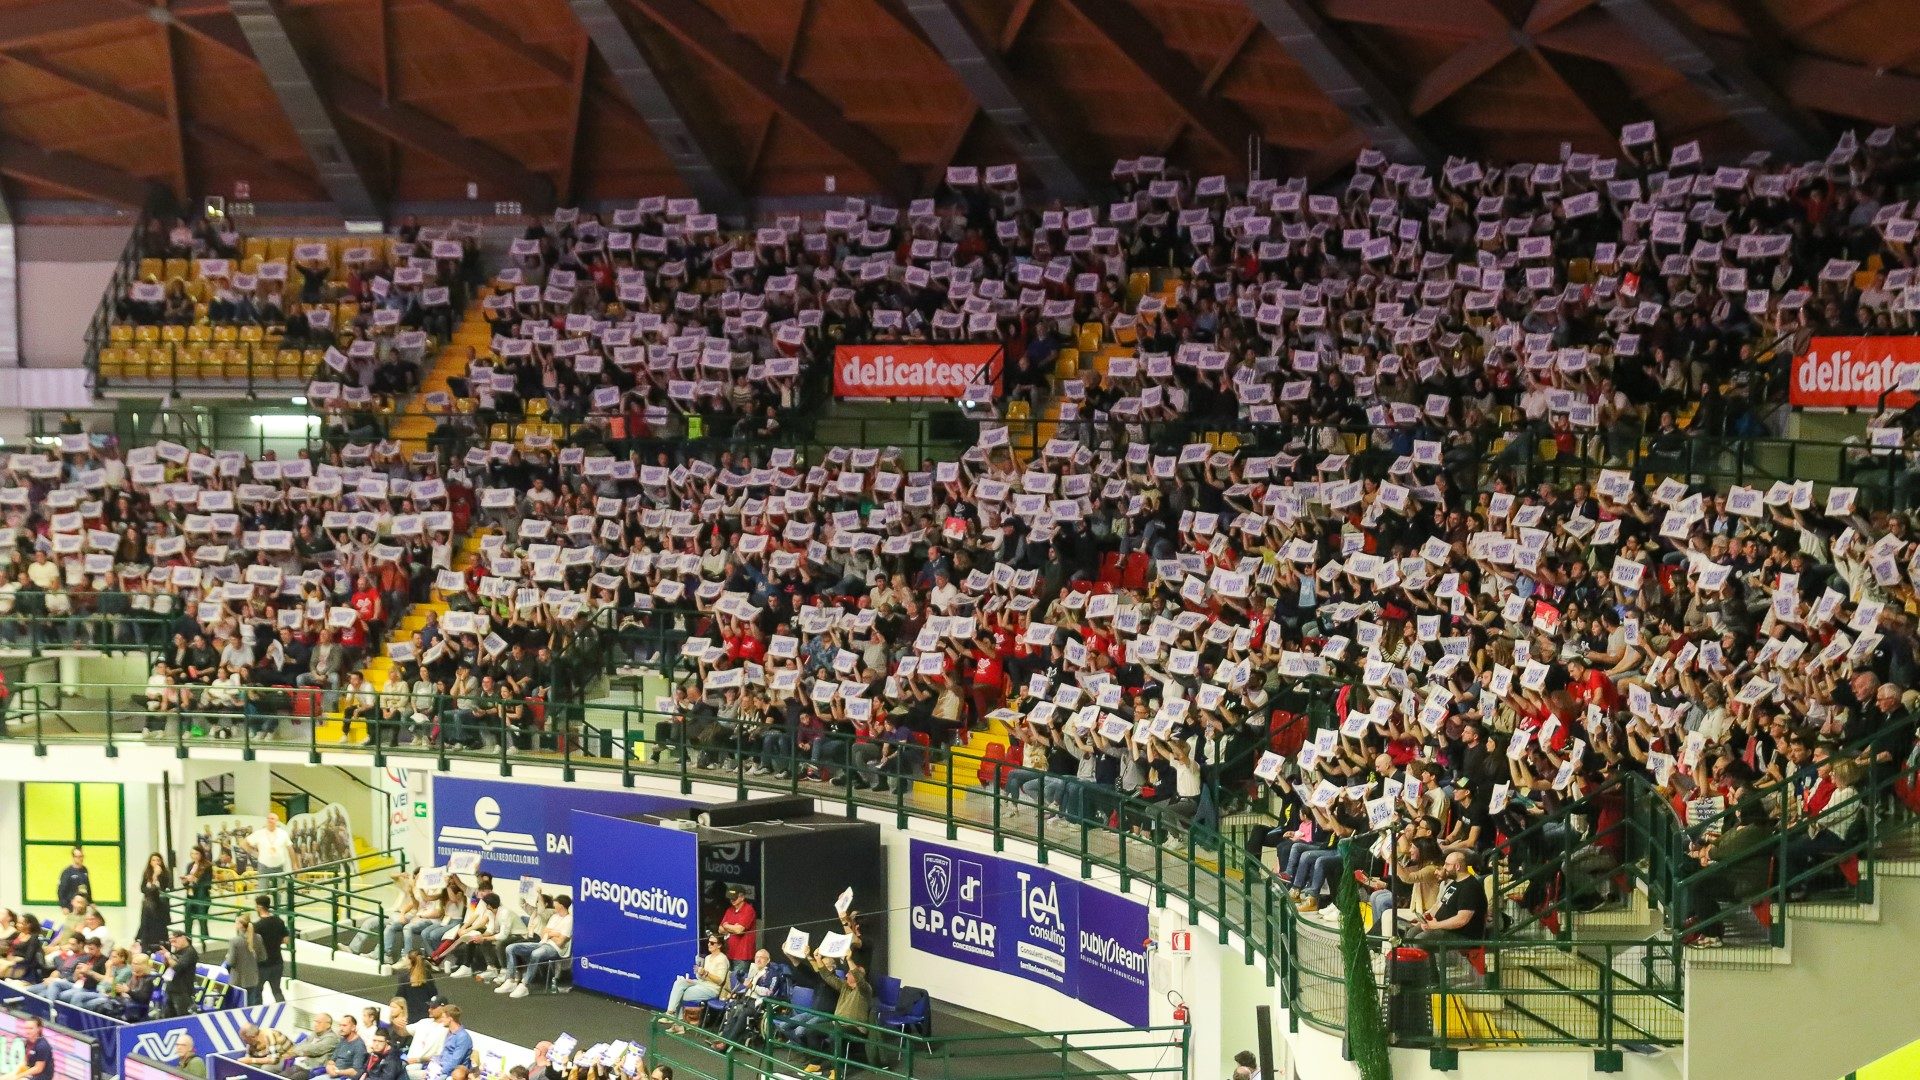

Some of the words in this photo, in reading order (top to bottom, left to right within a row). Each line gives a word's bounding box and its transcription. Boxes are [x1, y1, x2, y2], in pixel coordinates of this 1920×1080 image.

[580, 876, 689, 919] pesopositivo
[912, 905, 948, 936] G.P.
[951, 915, 995, 949] CAR
[1029, 923, 1066, 953] consulting
